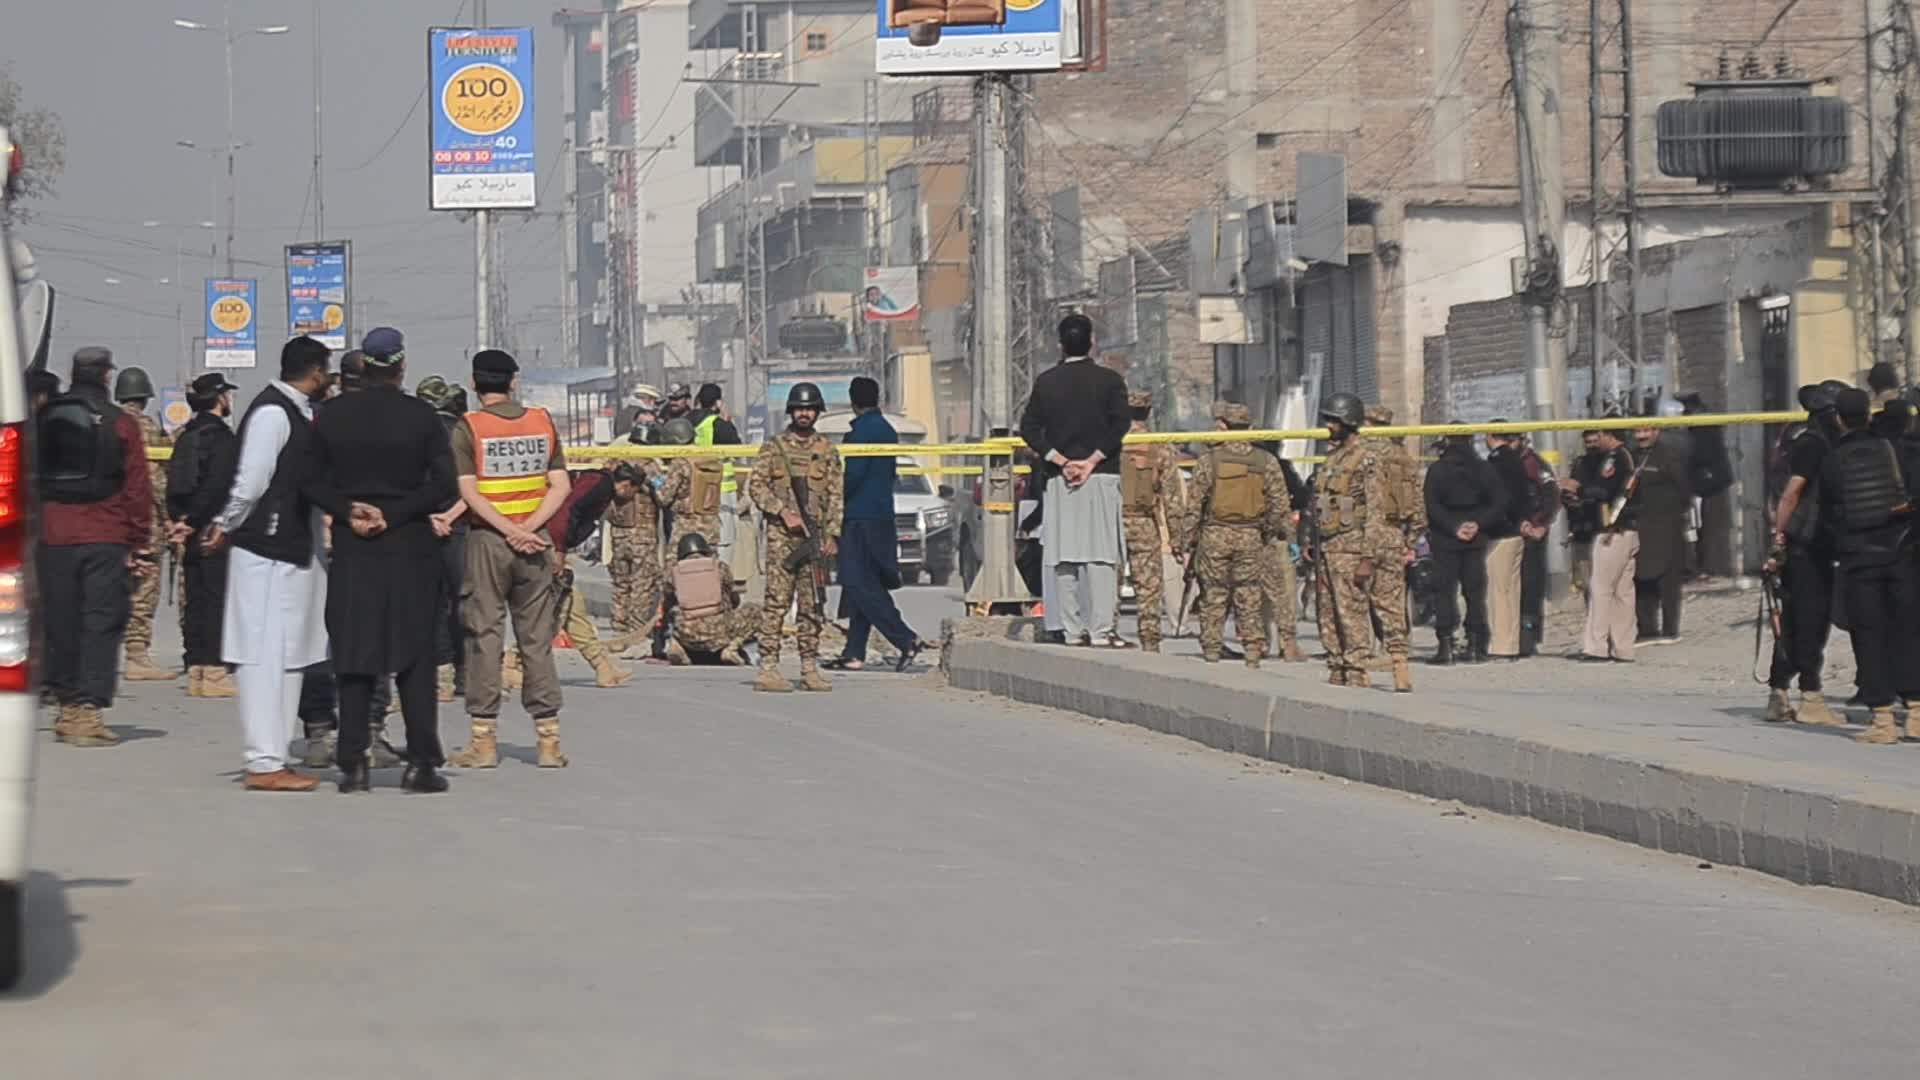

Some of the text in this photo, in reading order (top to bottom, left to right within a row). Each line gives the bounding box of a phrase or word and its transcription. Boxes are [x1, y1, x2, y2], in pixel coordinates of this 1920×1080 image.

[456, 78, 508, 98] 100
[495, 135, 517, 149] 40
[487, 438, 545, 457] RESCUE
